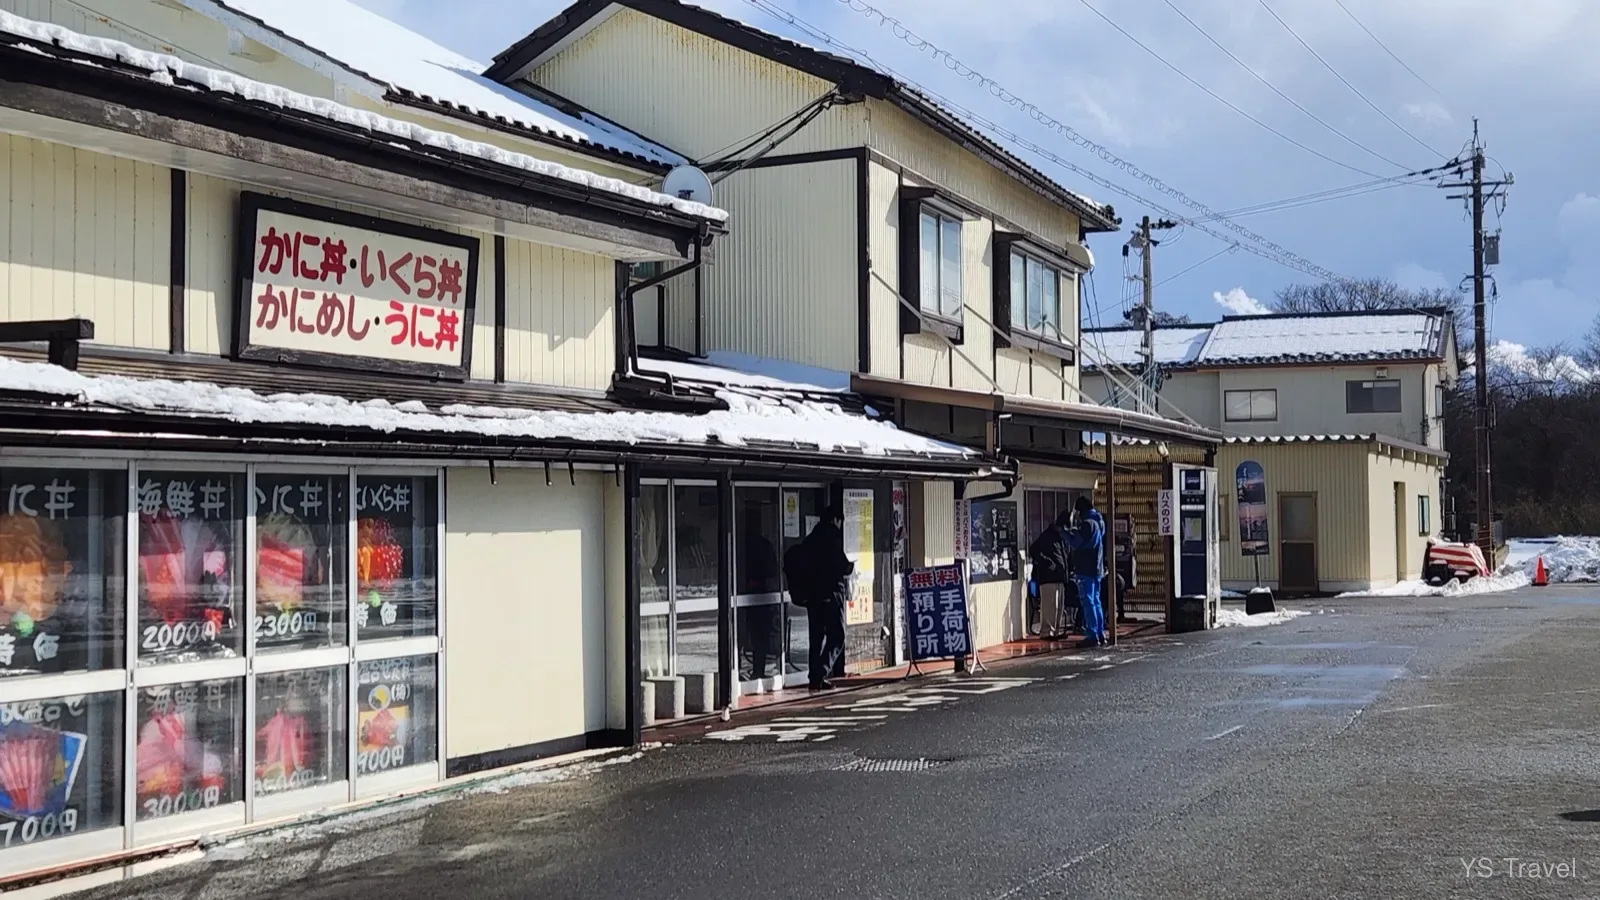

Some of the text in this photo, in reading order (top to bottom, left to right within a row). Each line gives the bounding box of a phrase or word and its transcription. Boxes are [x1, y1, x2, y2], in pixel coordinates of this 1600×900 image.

[258, 226, 463, 304] かに丼・いくら丼
[256, 283, 459, 352] かにめし・うに丼
[138, 478, 226, 519] 海鮮丼
[1161, 491, 1171, 534] バスのりば
[908, 568, 962, 590] 無料
[143, 620, 217, 649] 2000円
[911, 592, 939, 655] 預り所
[940, 589, 967, 653] 手荷物
[144, 785, 220, 820] 3000円
